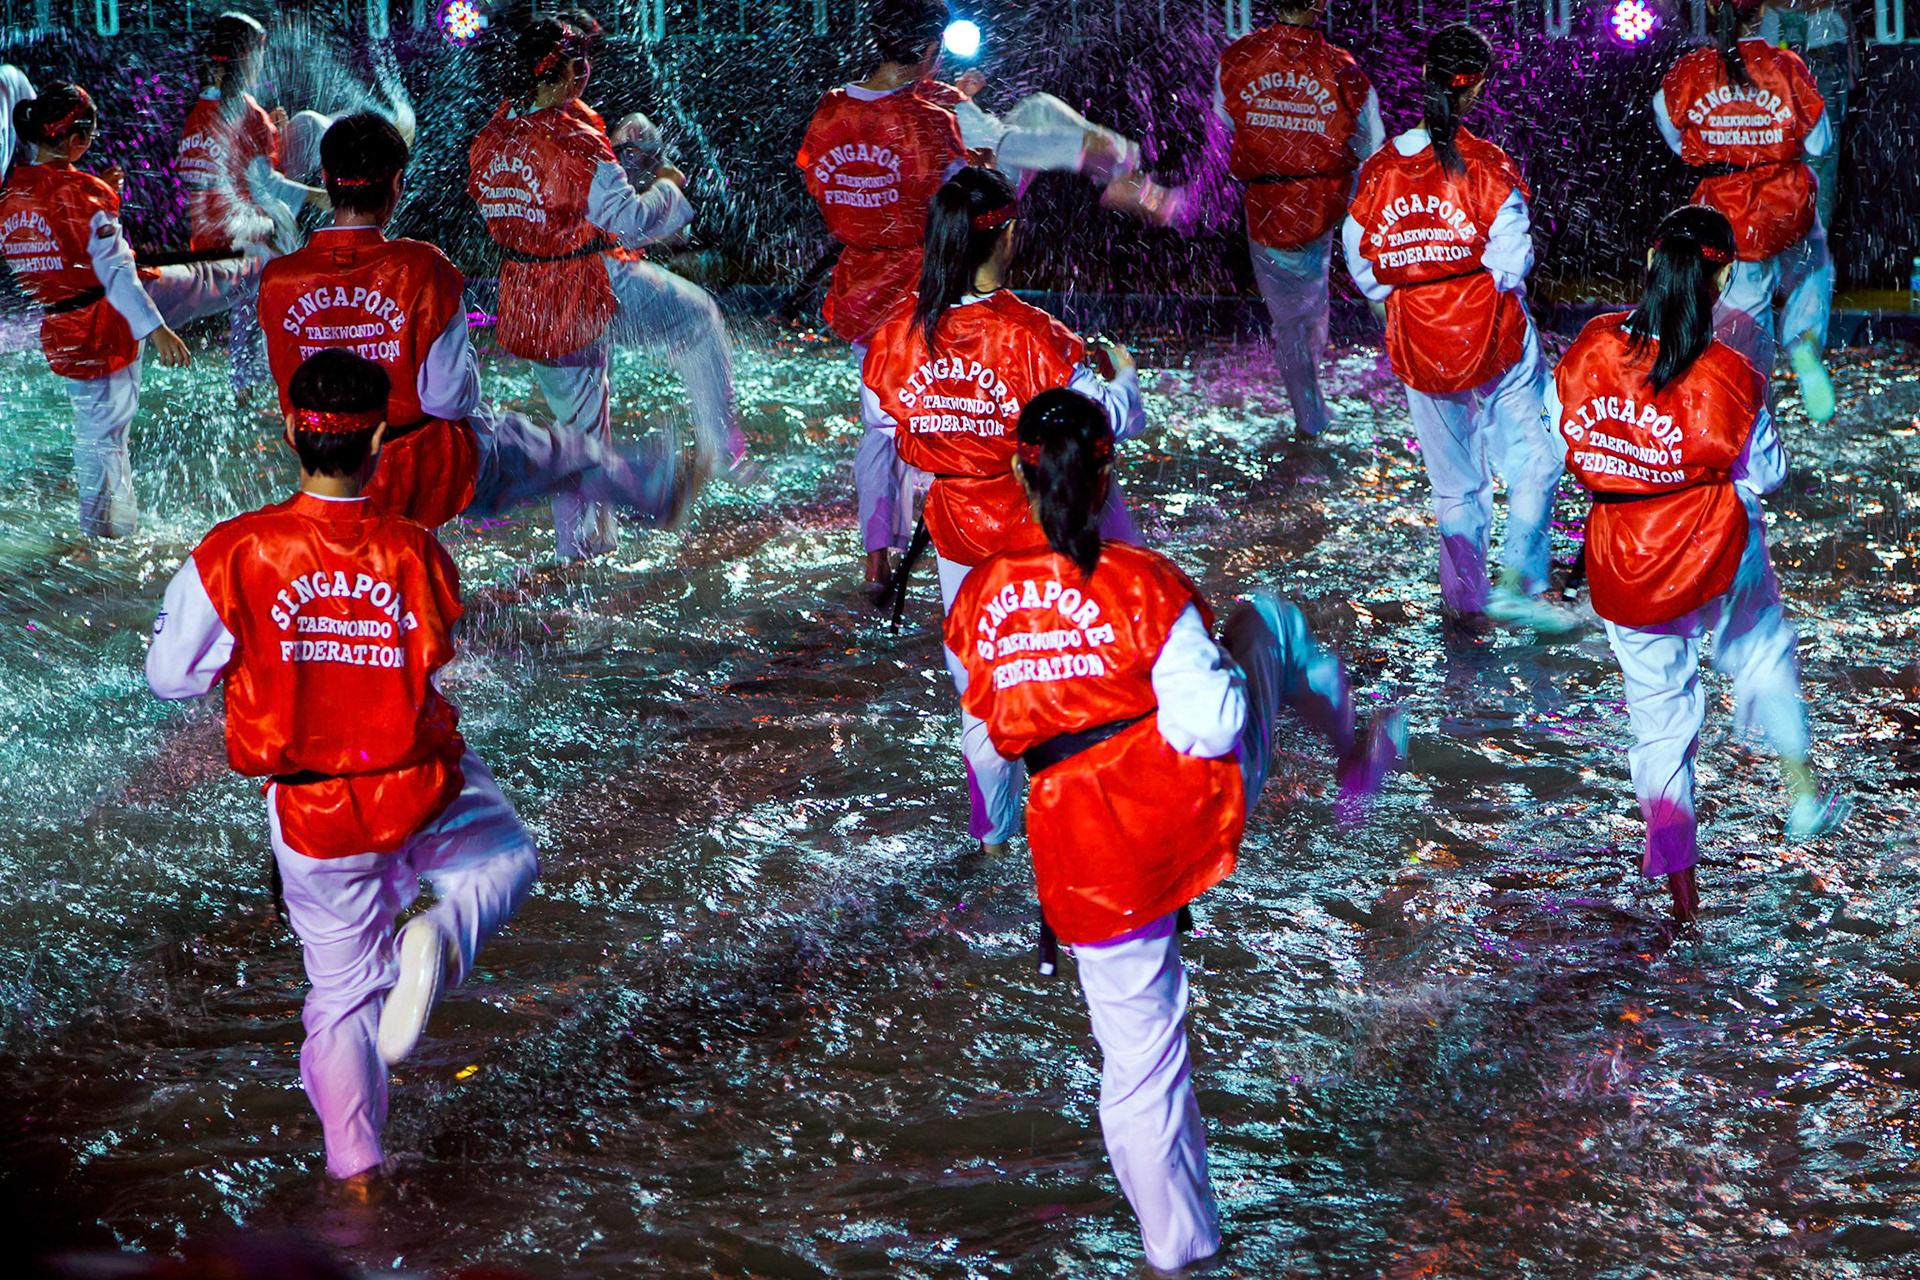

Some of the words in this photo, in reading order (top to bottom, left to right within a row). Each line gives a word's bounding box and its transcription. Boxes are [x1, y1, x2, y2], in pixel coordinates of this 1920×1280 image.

[1240, 72, 1337, 115] SINGAPORE
[1257, 98, 1317, 115] TAEKWONDO
[1688, 85, 1792, 125] SINGAPORE
[1246, 112, 1325, 133] FEDERATION
[1708, 115, 1772, 127] TAEKWONDO
[1700, 130, 1783, 145] FEDERATION
[834, 174, 895, 188] TAEKWONDO
[824, 188, 899, 208] FEDERATIO
[1370, 193, 1477, 247] SINGAPORE
[1387, 228, 1455, 247] TAEKWONDO
[1378, 245, 1472, 269] FEDERATION
[283, 286, 406, 337] SINGAPORE
[305, 322, 385, 340] TAEKWONDO
[898, 357, 1020, 417] SINGAPORE
[923, 394, 996, 415] TAEKWONDO
[909, 414, 1005, 438] FEDERATION
[1563, 395, 1683, 466] SINGAPORE
[1589, 430, 1669, 466] TAEKWONDO
[1573, 451, 1686, 484] FEDERATION
[271, 570, 418, 637] SINGAPORE
[297, 616, 392, 639] TAEKWONDO
[976, 579, 1116, 661] SINGAPORE
[280, 640, 405, 668] FEDERATION
[992, 653, 1105, 691] EDERATION
